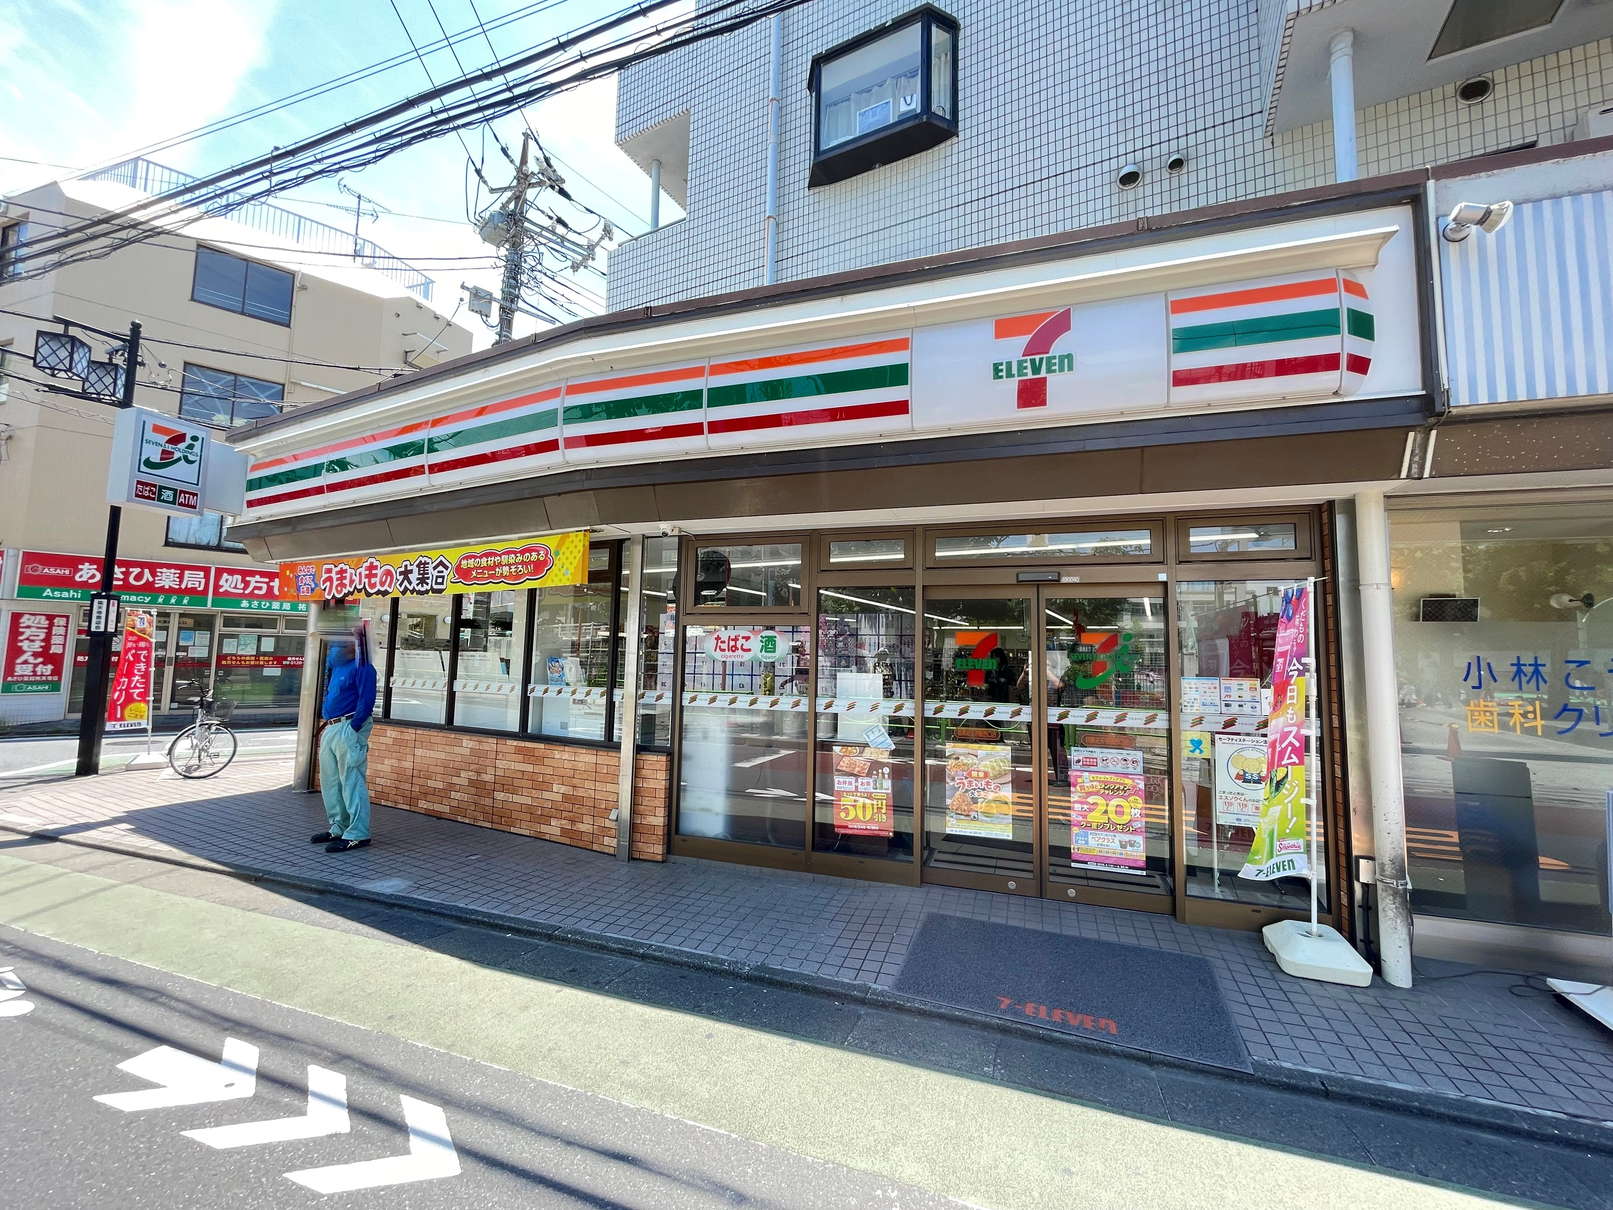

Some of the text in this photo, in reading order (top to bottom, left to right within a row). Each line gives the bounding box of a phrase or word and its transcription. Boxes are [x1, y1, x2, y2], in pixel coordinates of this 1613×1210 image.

[993, 307, 1072, 409] 7
[135, 484, 157, 498] たばこ
[160, 489, 174, 502] 酒
[178, 493, 198, 507] ATM
[43, 567, 70, 576] ASAHI
[74, 562, 206, 591] あさひ薬局
[321, 557, 451, 600] うまいもの大集合
[42, 588, 82, 599] Asahi
[240, 601, 291, 611] あさひ薬局
[15, 614, 49, 664] 処方せん
[714, 634, 752, 652] たばこ
[760, 635, 777, 653] 酒
[14, 664, 55, 675] 受付
[129, 650, 149, 700] できたて
[1463, 655, 1613, 691] 小林こ
[113, 650, 136, 718] ベーカリー
[1281, 657, 1303, 832] 今日もスムージー！
[955, 777, 1002, 792] うまいもの
[1086, 795, 1132, 825] 20
